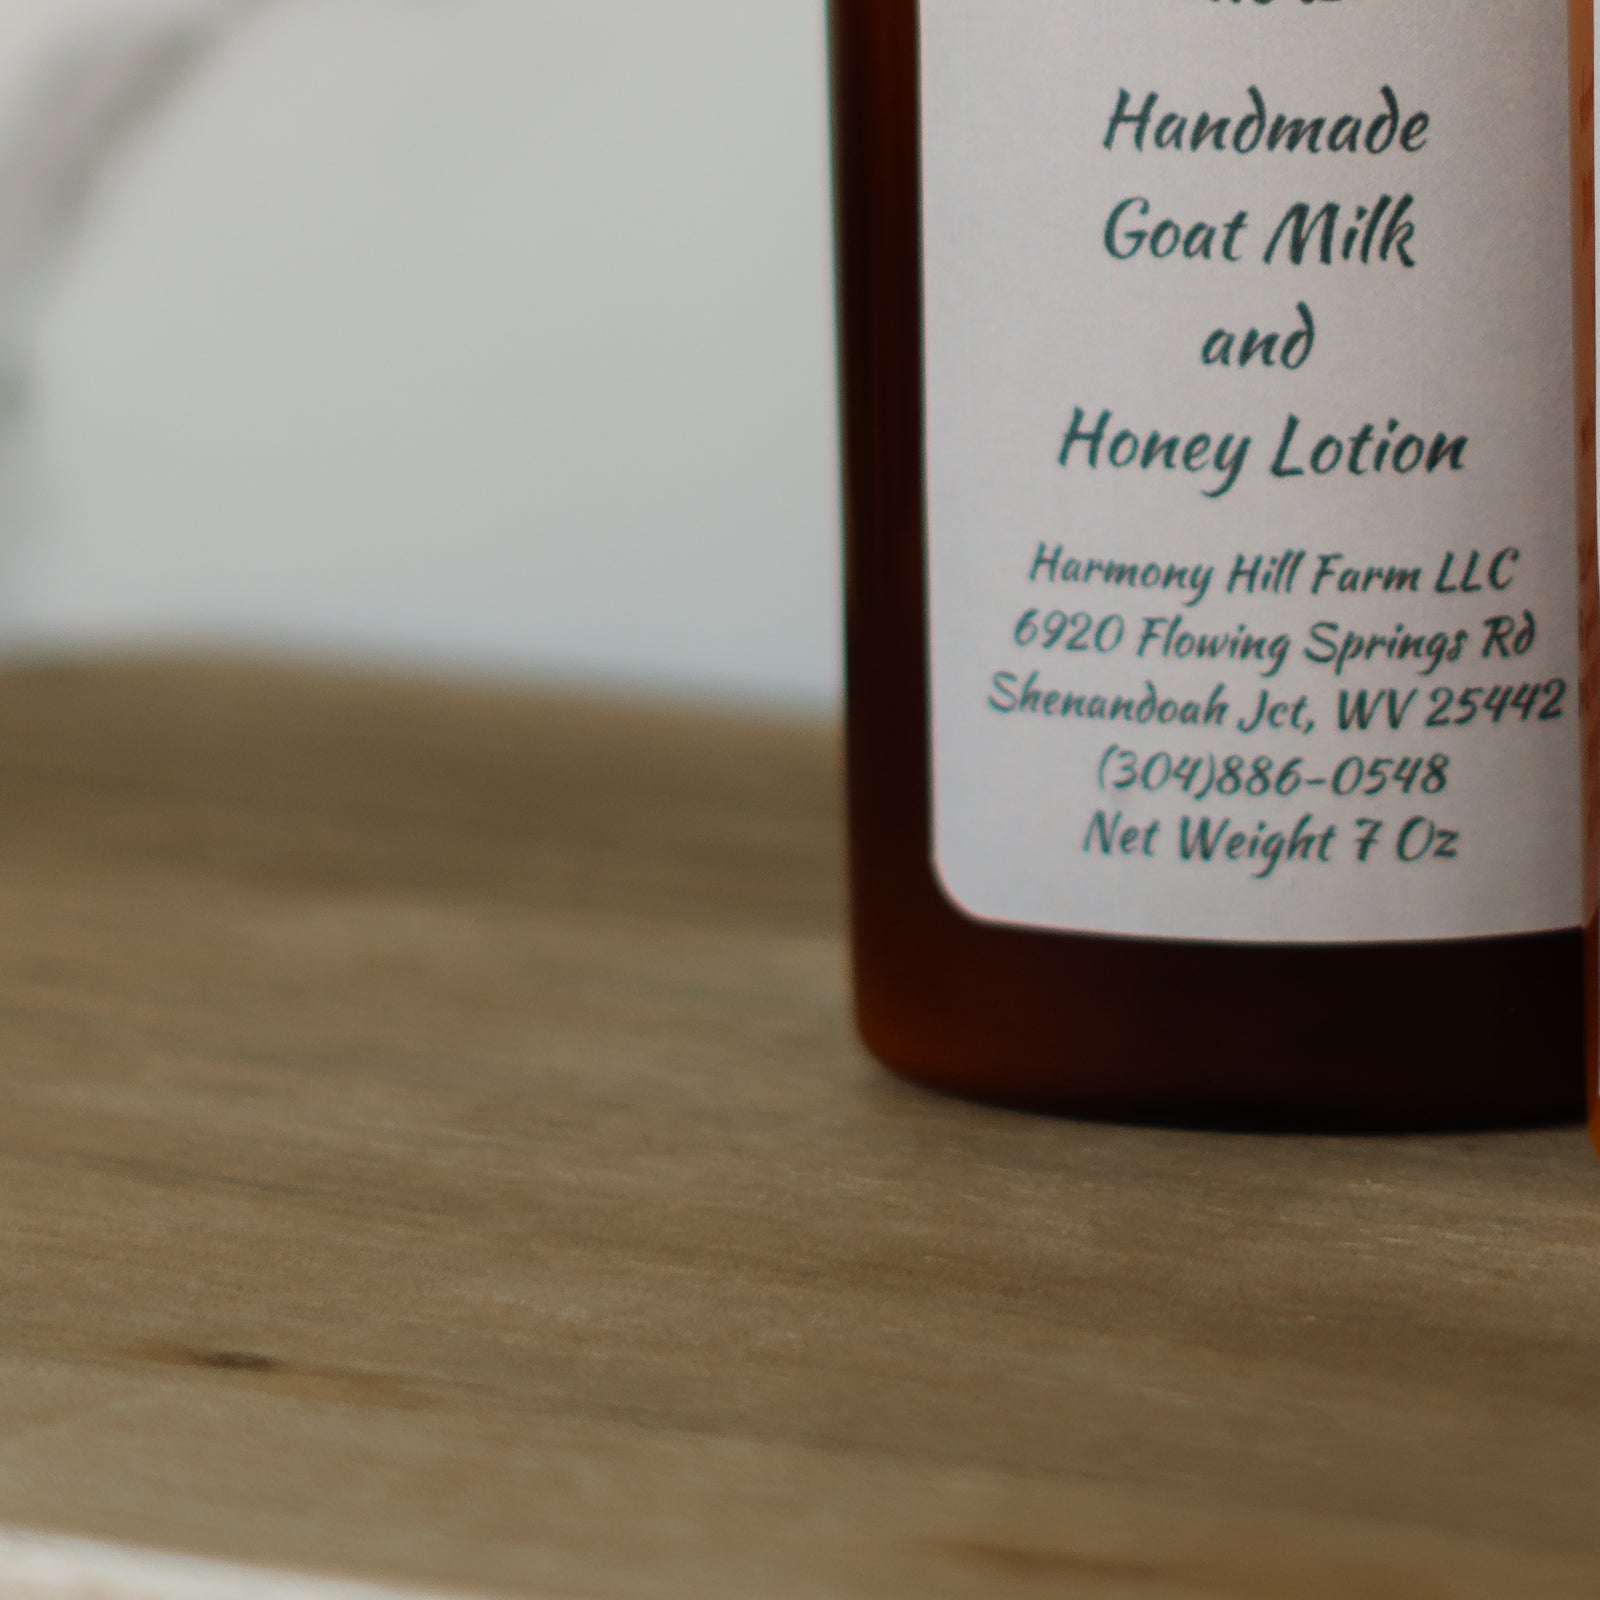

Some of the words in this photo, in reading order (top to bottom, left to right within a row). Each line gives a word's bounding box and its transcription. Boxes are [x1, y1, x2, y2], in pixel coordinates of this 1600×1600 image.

[1102, 84, 1431, 155] Handmade
[1102, 196, 1249, 263] Goat
[1262, 192, 1416, 269] Milk
[1200, 300, 1316, 371] and
[1057, 406, 1252, 499] Honey
[1269, 413, 1469, 479] Lotion
[1029, 542, 1215, 608] Harmony
[1226, 549, 1306, 594] Hill
[1310, 553, 1422, 595] Farm
[1433, 546, 1521, 595] LLC
[1014, 608, 1124, 653] 6920
[1136, 614, 1291, 678] Flowing
[1303, 621, 1469, 676] Springs
[1481, 608, 1538, 659] Rd
[988, 671, 1229, 725] Shenandoah
[1236, 689, 1315, 735] Jct,
[1337, 688, 1418, 731] WV
[1428, 677, 1567, 726] 25442
[1098, 744, 1450, 801] (304)886-0548
[1083, 809, 1160, 857] Net
[1179, 813, 1337, 879] Weight
[1355, 817, 1383, 862] 7
[1395, 815, 1459, 863] Oz
